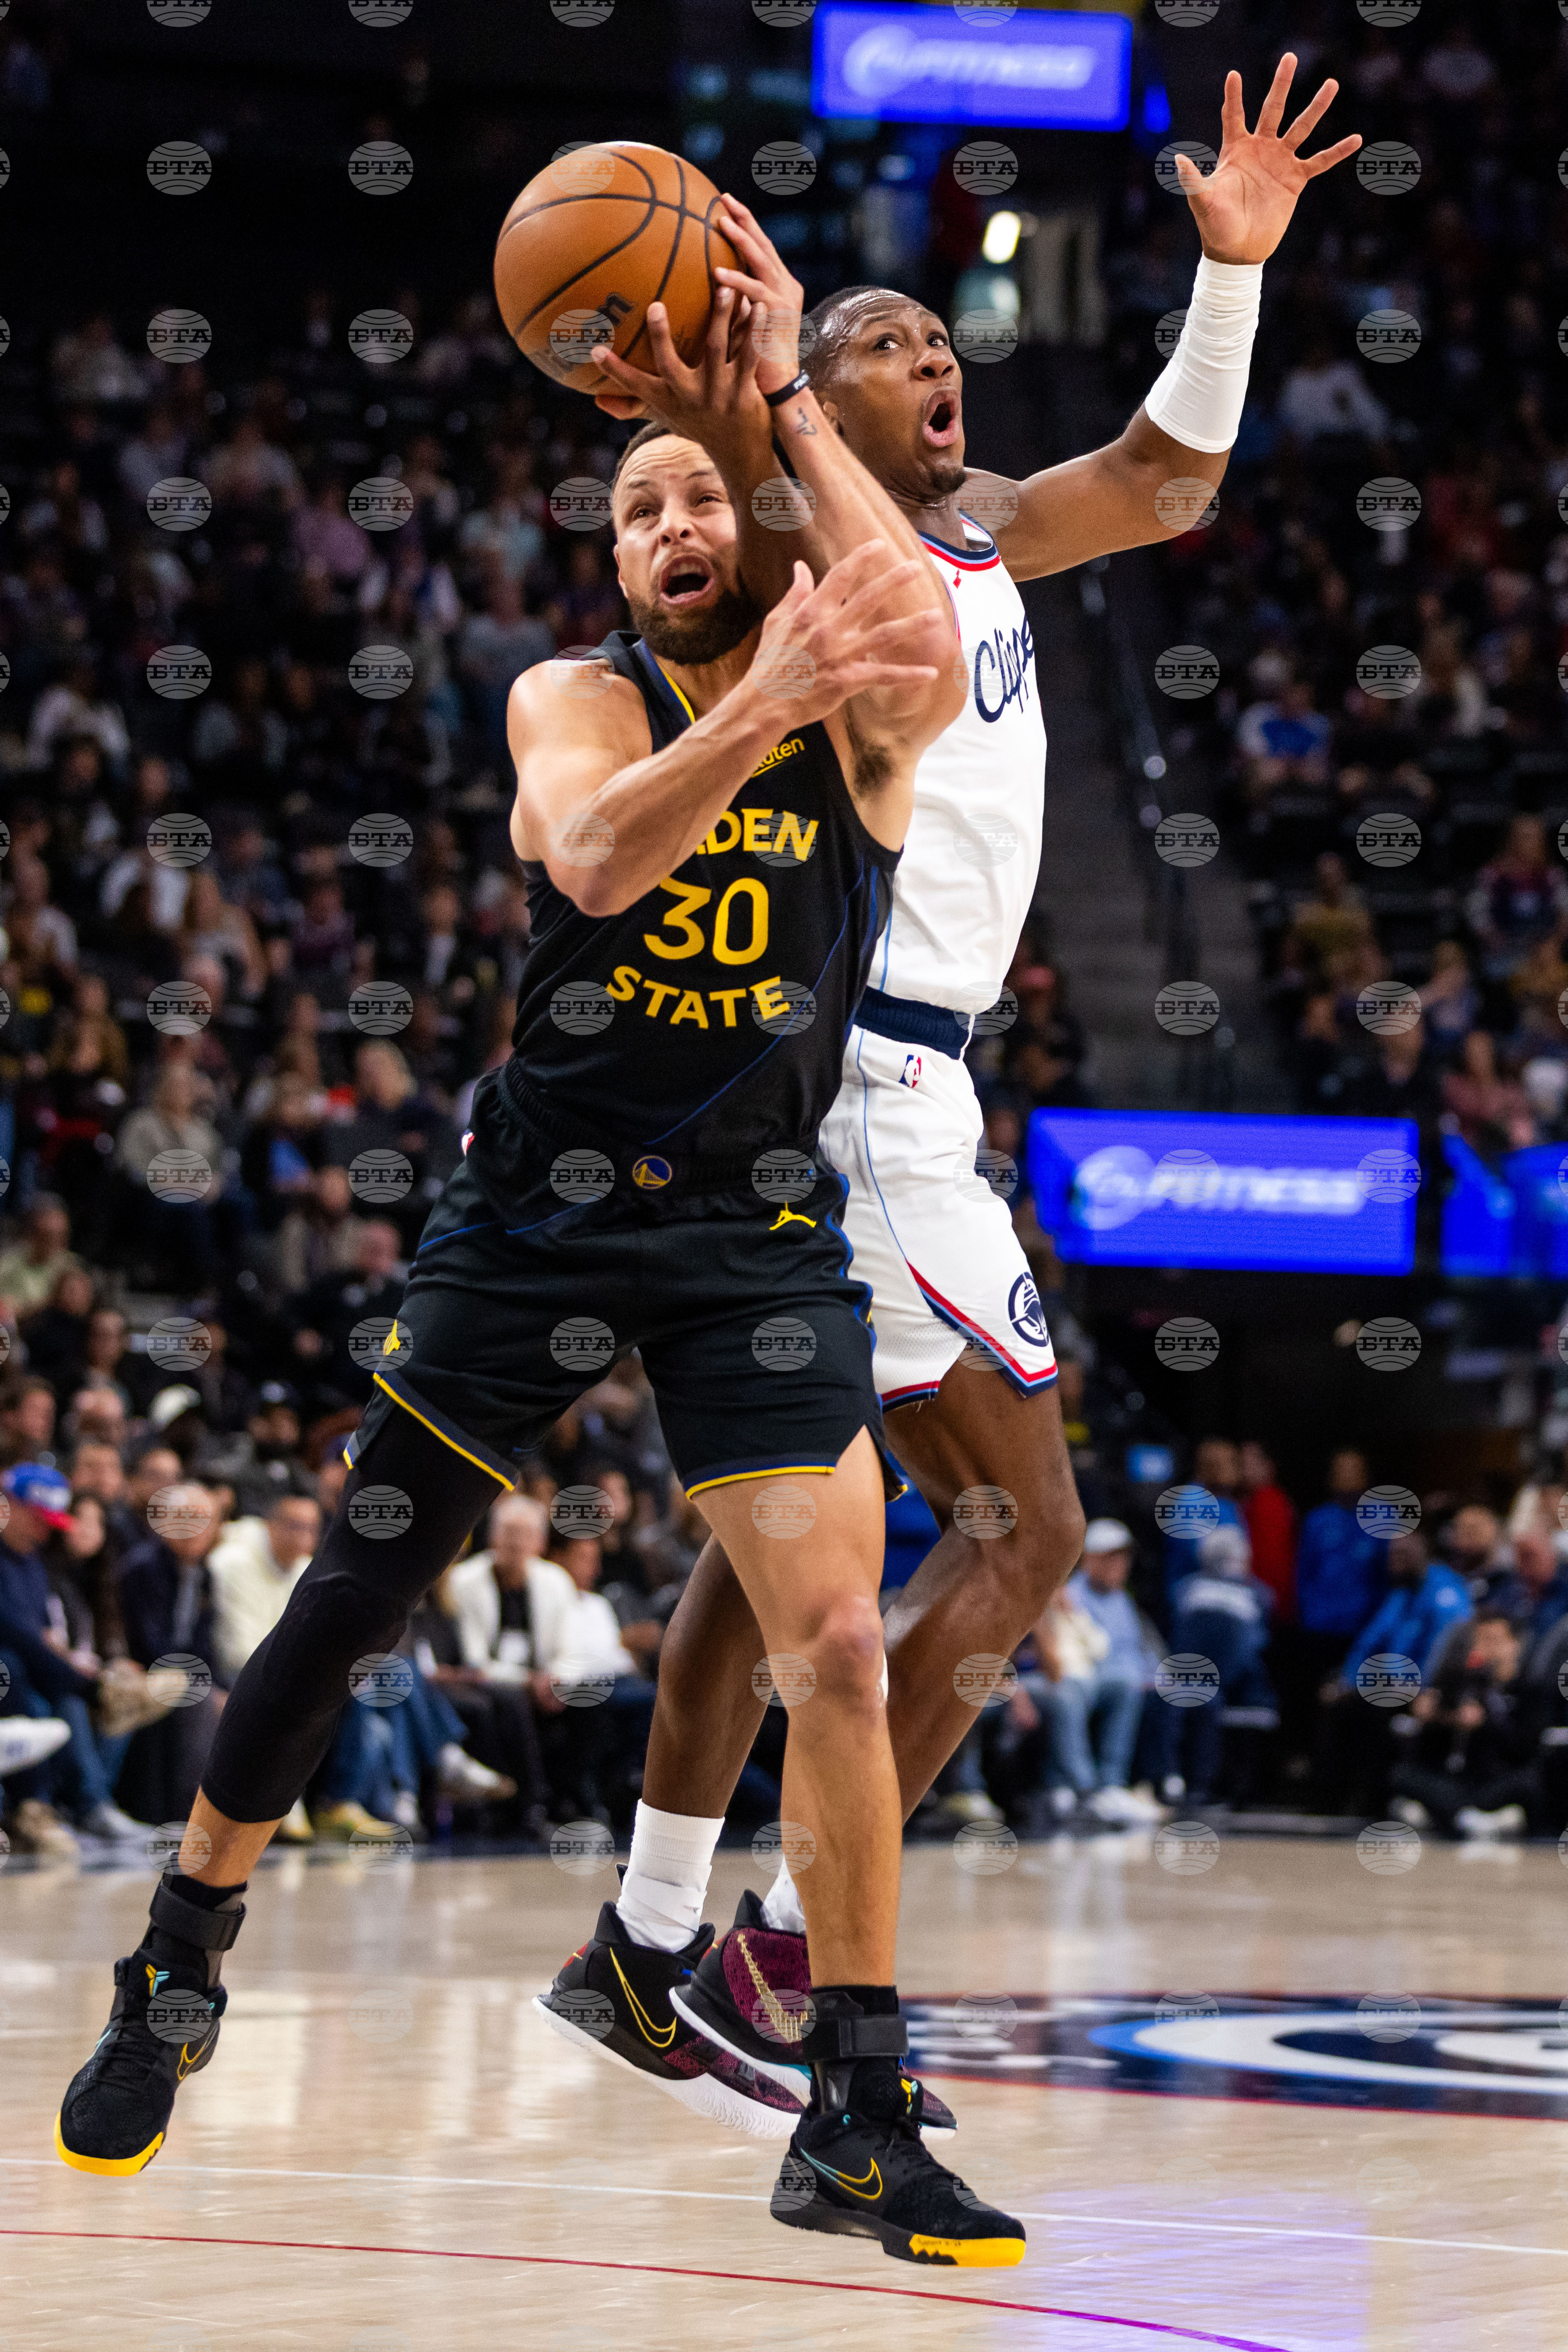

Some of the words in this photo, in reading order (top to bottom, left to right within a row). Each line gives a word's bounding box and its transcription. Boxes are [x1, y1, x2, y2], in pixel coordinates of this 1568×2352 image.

[759, 738, 805, 768] uten
[697, 808, 819, 861] DEN
[643, 877, 769, 965] 30
[605, 965, 790, 1029] STATE
